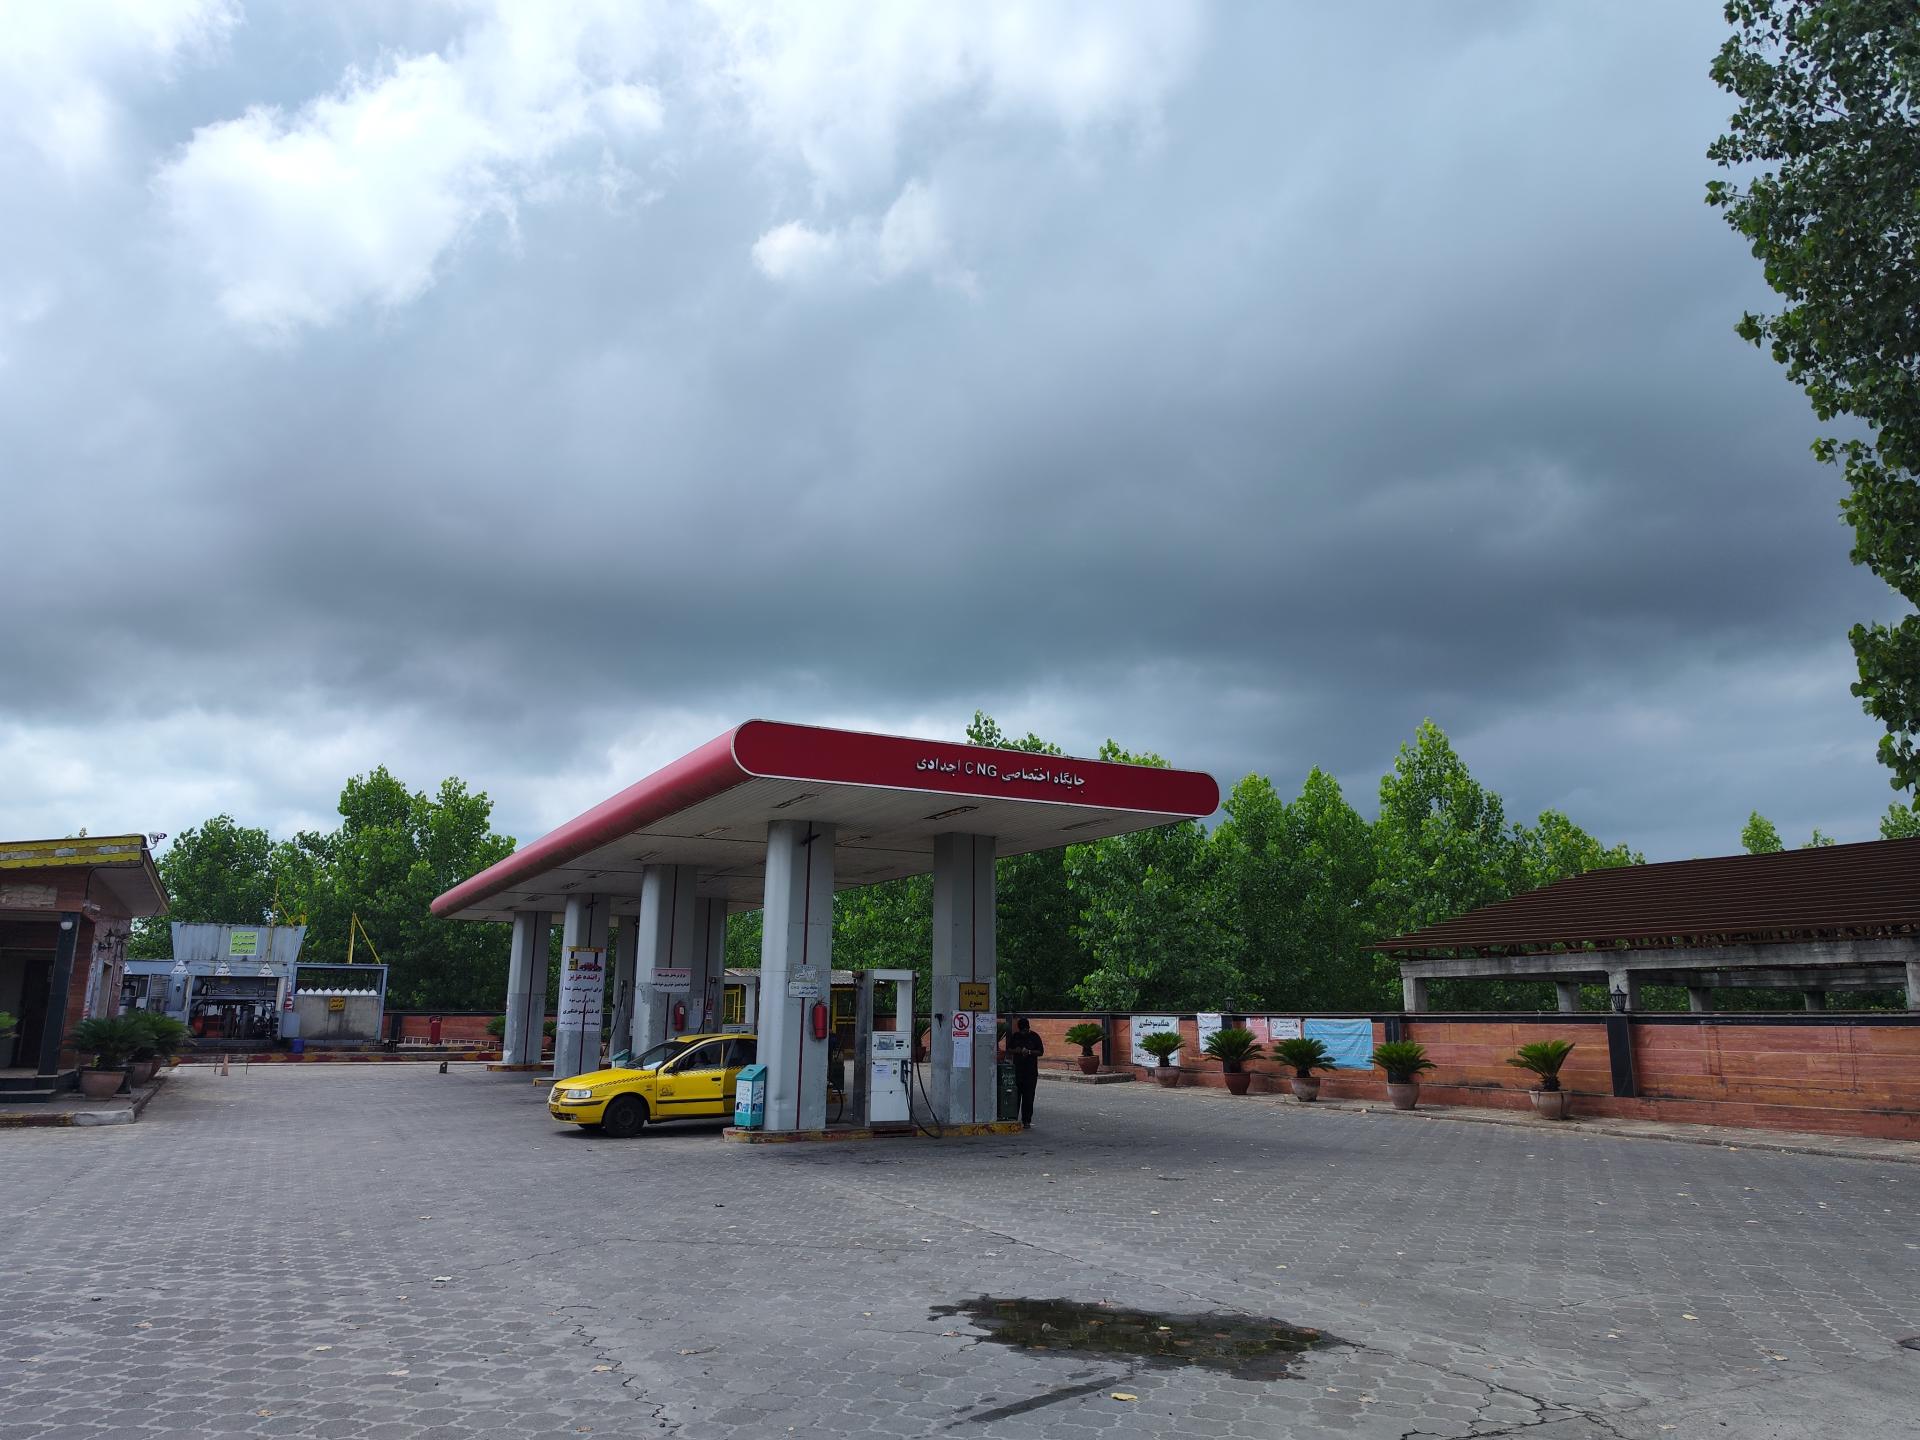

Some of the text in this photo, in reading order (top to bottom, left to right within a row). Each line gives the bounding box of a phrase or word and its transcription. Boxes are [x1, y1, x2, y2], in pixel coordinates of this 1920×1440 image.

[965, 761, 997, 777] CNG
[1001, 767, 1050, 782] اختصاصی
[1053, 772, 1085, 794] جایگاه
